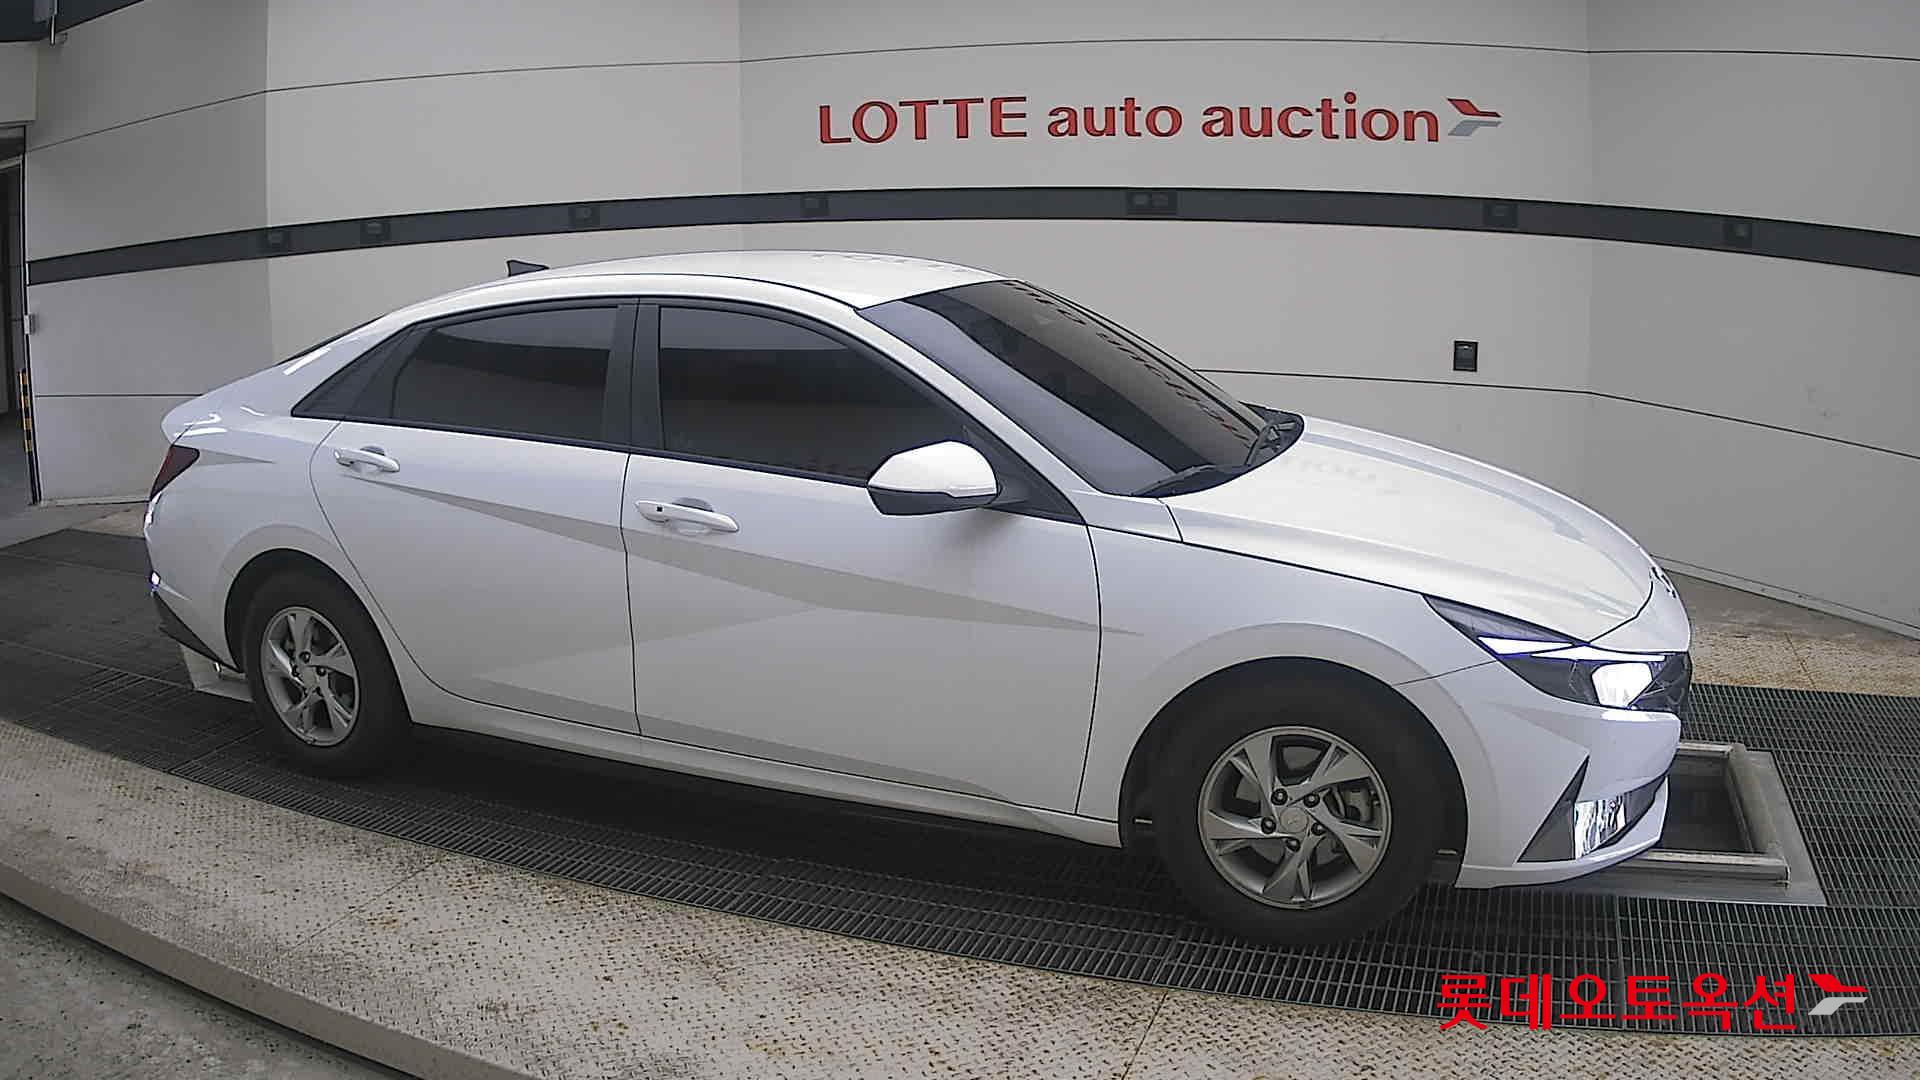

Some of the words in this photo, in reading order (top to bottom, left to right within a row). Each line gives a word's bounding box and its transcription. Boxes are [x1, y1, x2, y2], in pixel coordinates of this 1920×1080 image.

[818, 95, 1028, 144] LOTTE
[1047, 97, 1184, 138] auto
[1201, 91, 1440, 142] auction
